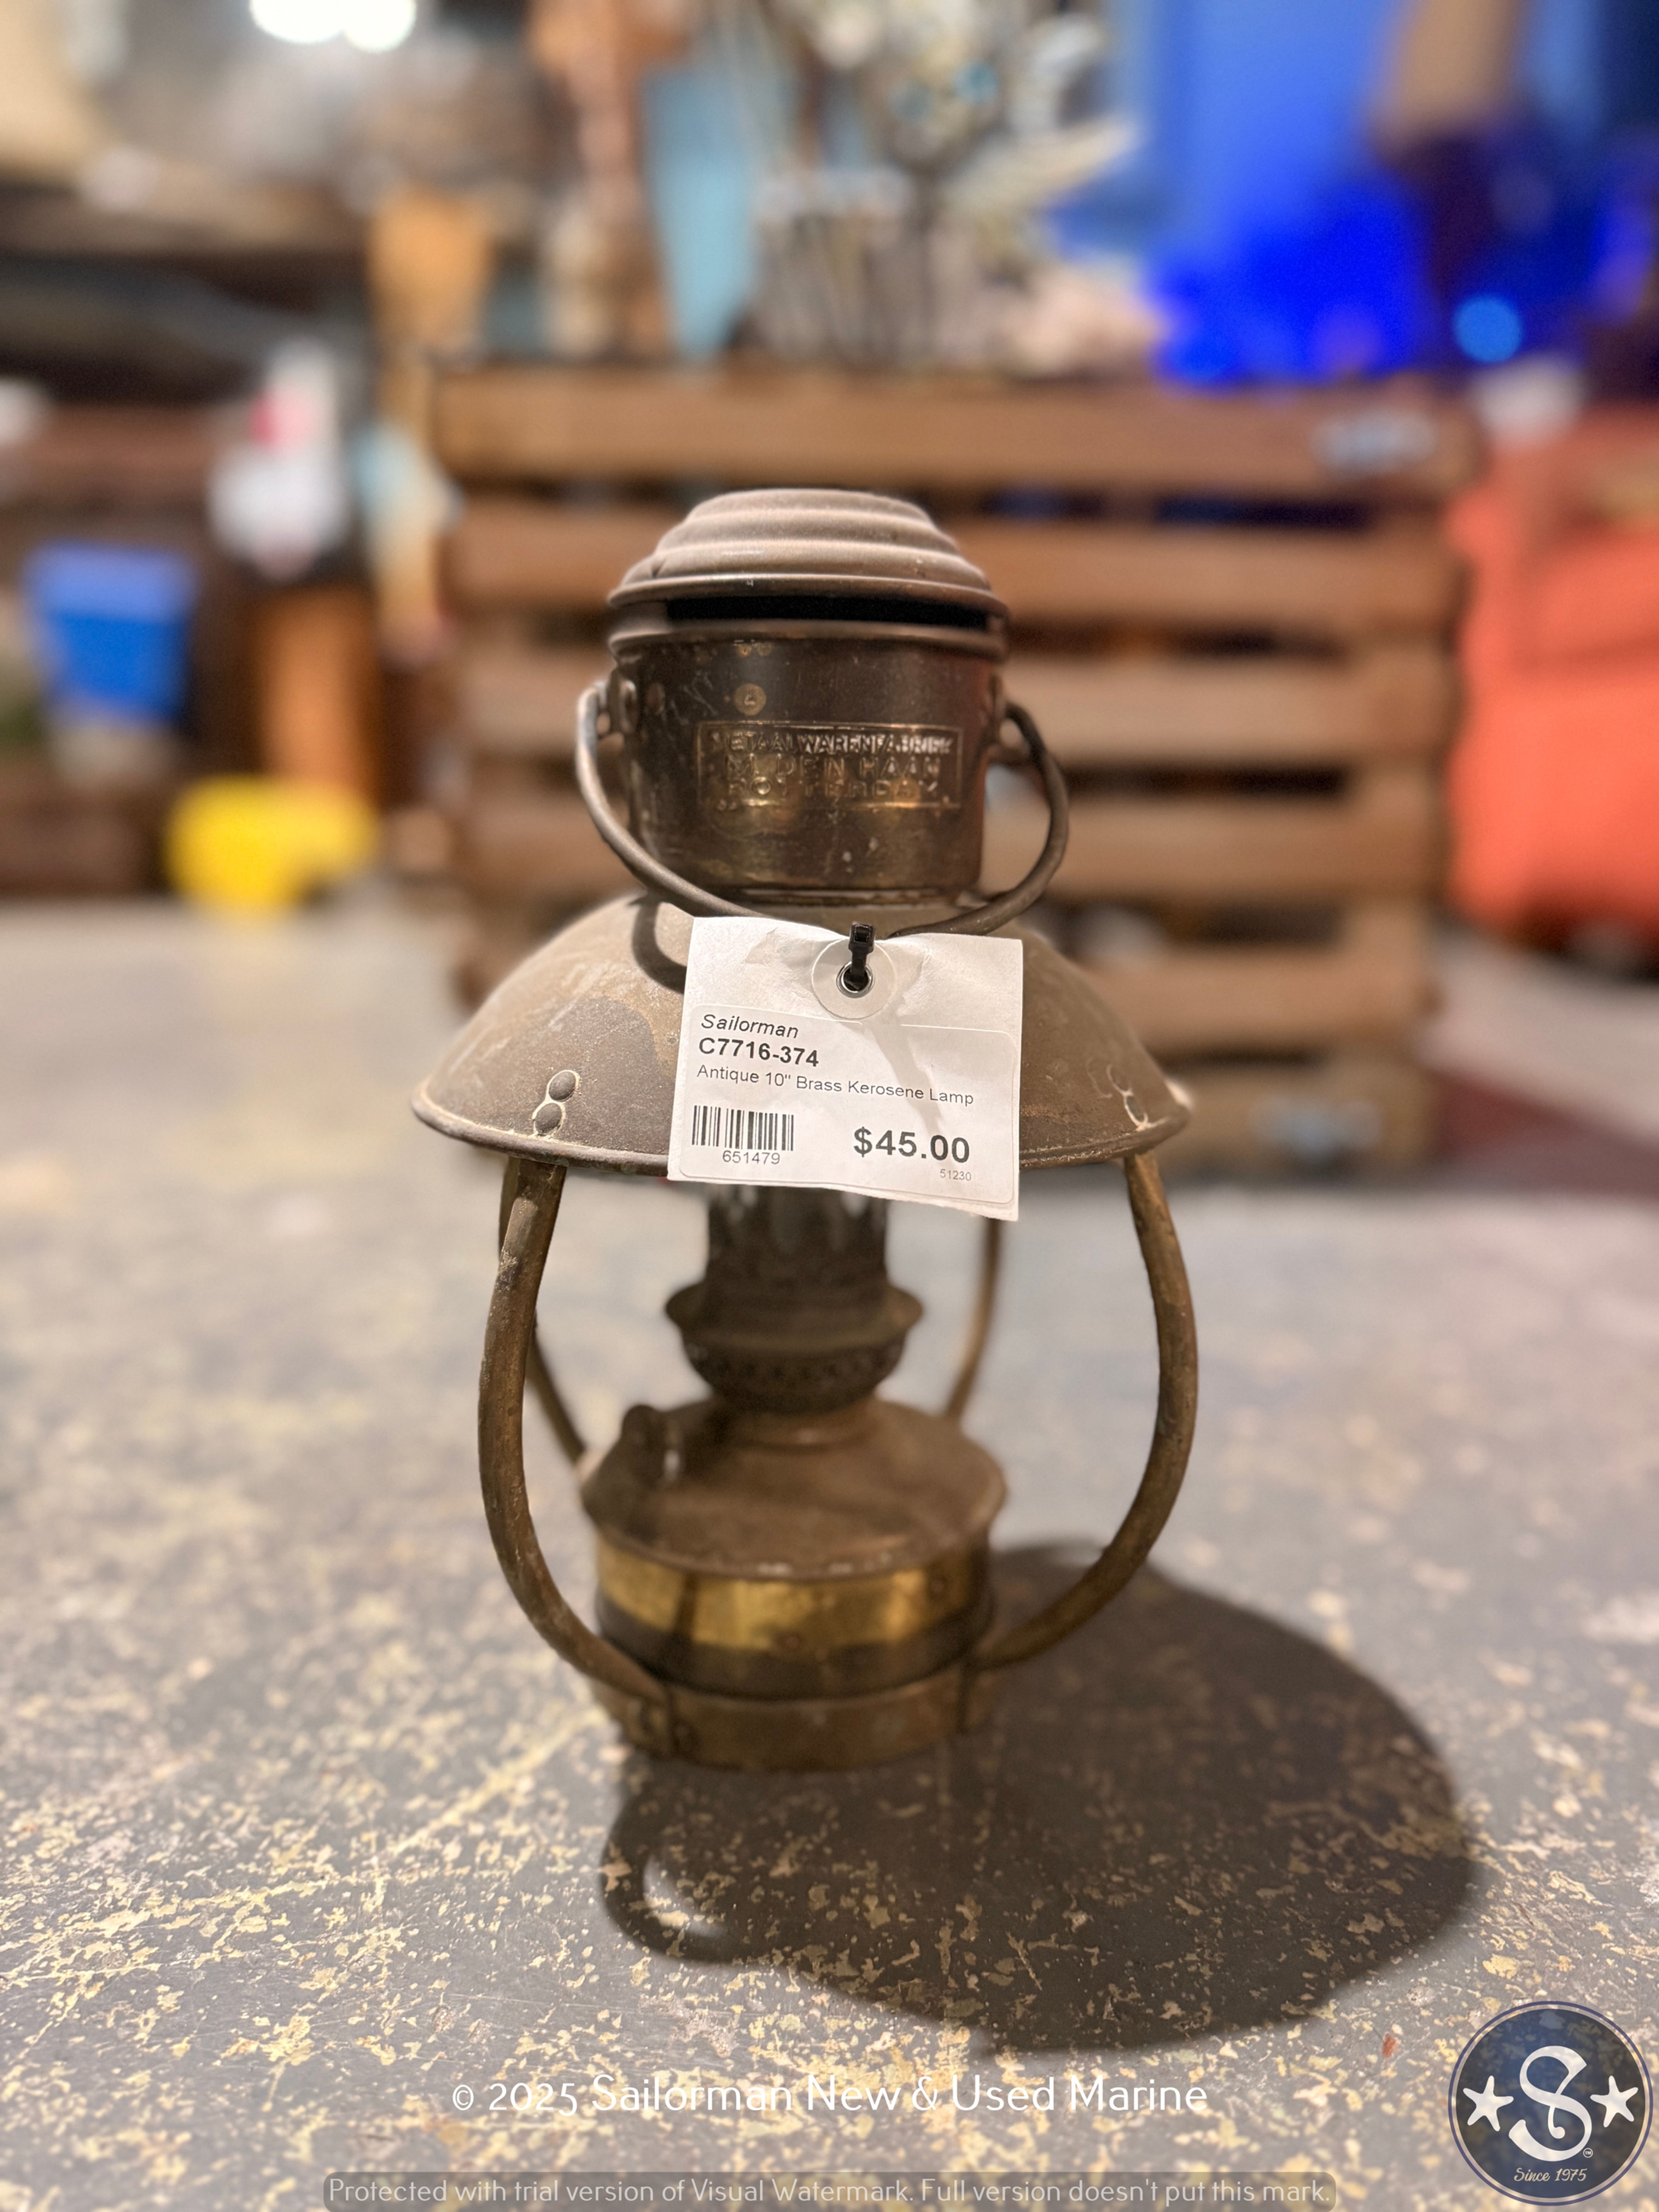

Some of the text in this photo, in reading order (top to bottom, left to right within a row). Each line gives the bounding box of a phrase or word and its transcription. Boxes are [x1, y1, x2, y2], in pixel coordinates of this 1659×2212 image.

[701, 1014, 799, 1039] Sailorman
[698, 1037, 819, 1067] C7716-374
[697, 1064, 974, 1107] Antique 10" Brass Kerosene Lamp
[722, 1150, 781, 1165] 651479
[853, 1126, 970, 1163] $45.00
[939, 1168, 972, 1182] 51230
